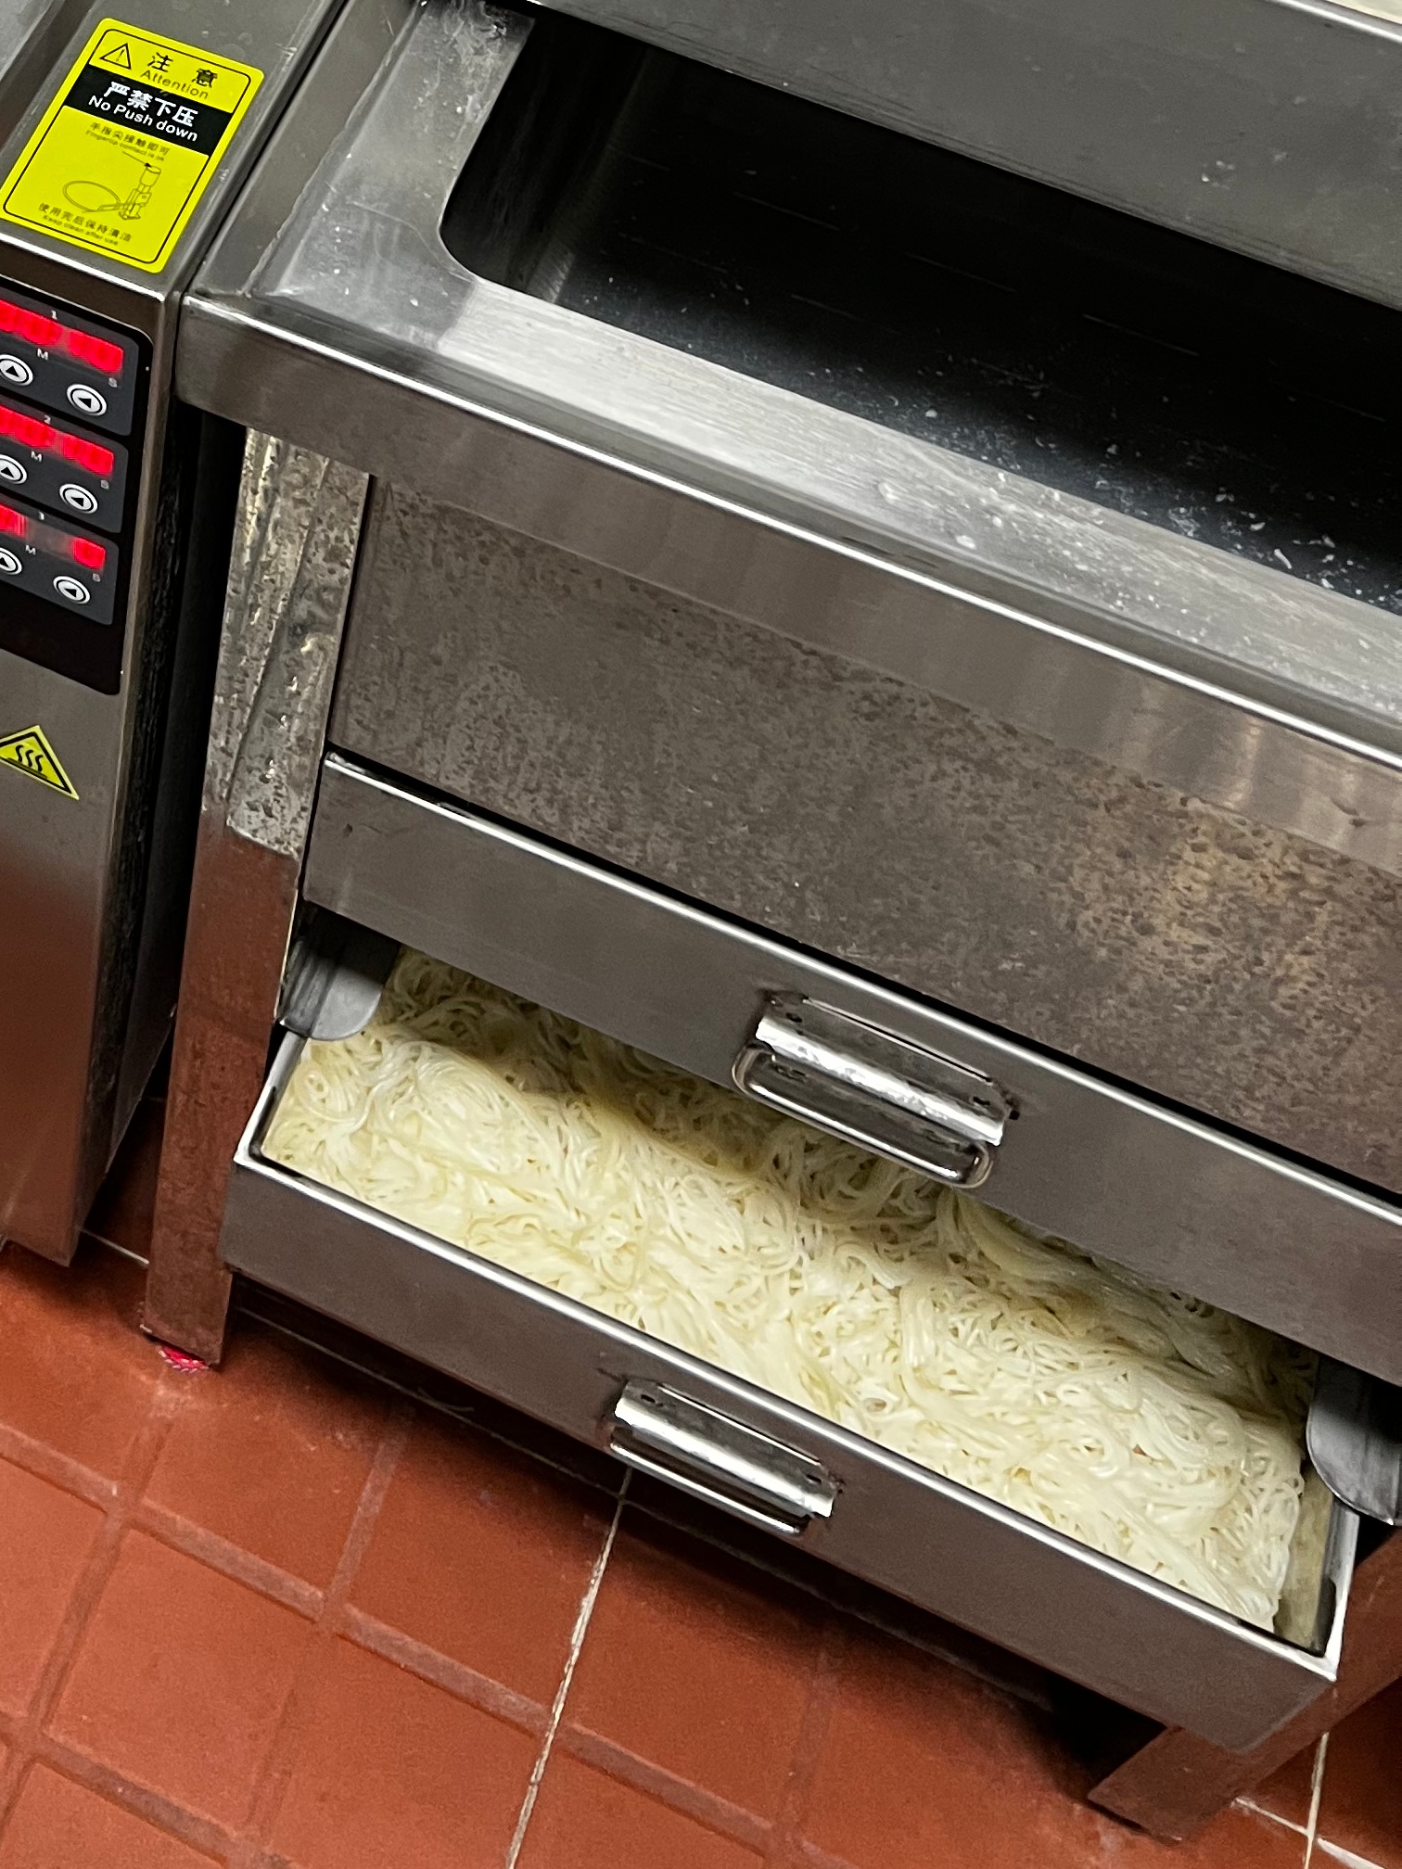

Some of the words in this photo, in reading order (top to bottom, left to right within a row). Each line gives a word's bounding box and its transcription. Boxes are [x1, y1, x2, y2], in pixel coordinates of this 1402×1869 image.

[140, 69, 209, 100] Attention
[147, 51, 218, 88] 注意
[88, 95, 112, 114] No
[114, 104, 154, 128] Push
[156, 119, 199, 142] down
[103, 81, 199, 128] 严禁下压
[36, 347, 49, 361] M
[30, 450, 43, 463] M
[25, 544, 37, 556] M
